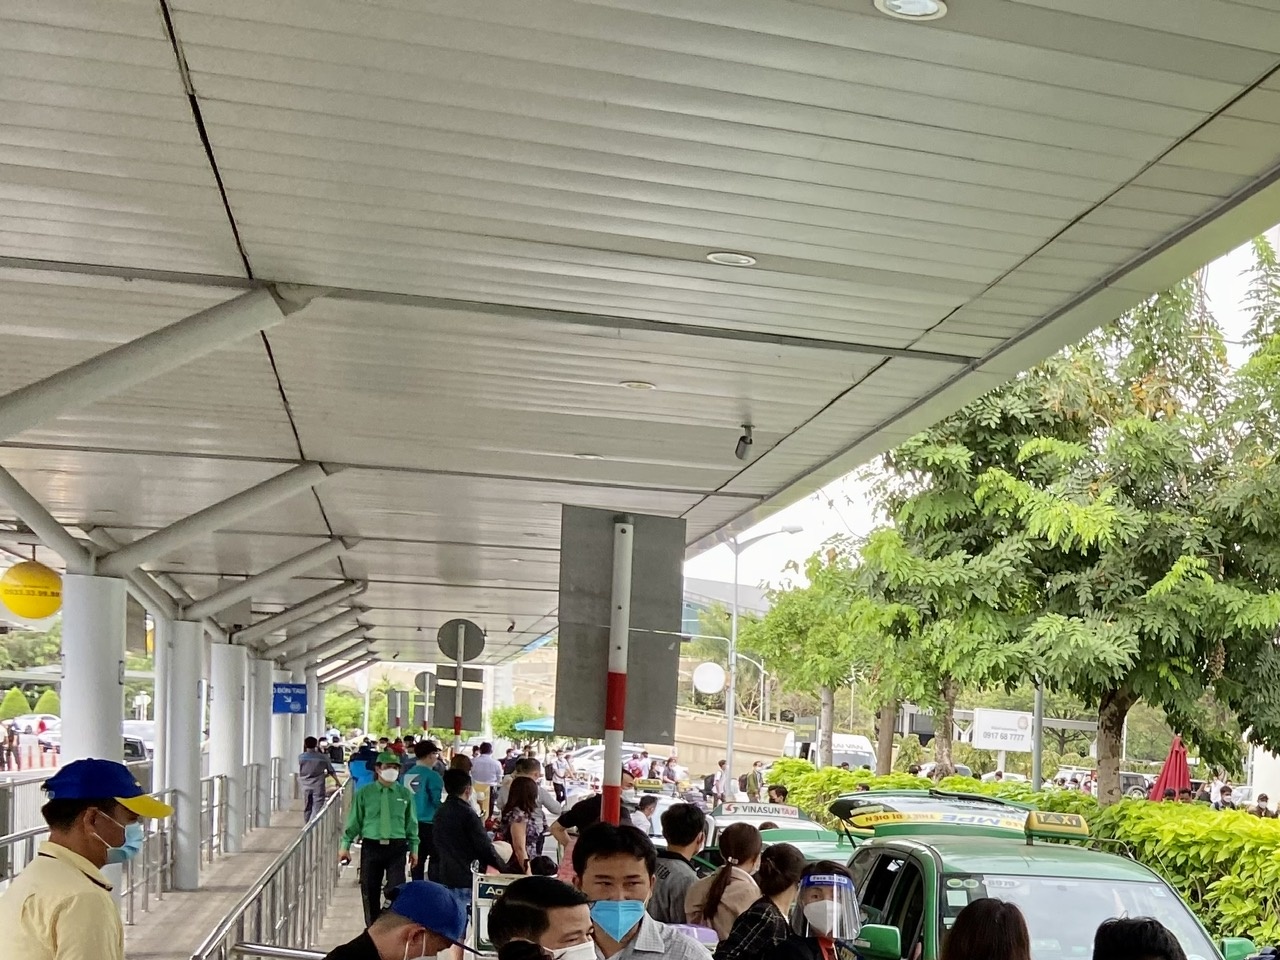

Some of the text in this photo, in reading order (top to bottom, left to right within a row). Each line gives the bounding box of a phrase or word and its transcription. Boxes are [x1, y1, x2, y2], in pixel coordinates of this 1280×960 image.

[982, 731, 999, 739] 0917
[1009, 733, 1025, 741] 7777
[940, 813, 1001, 826] MPE
